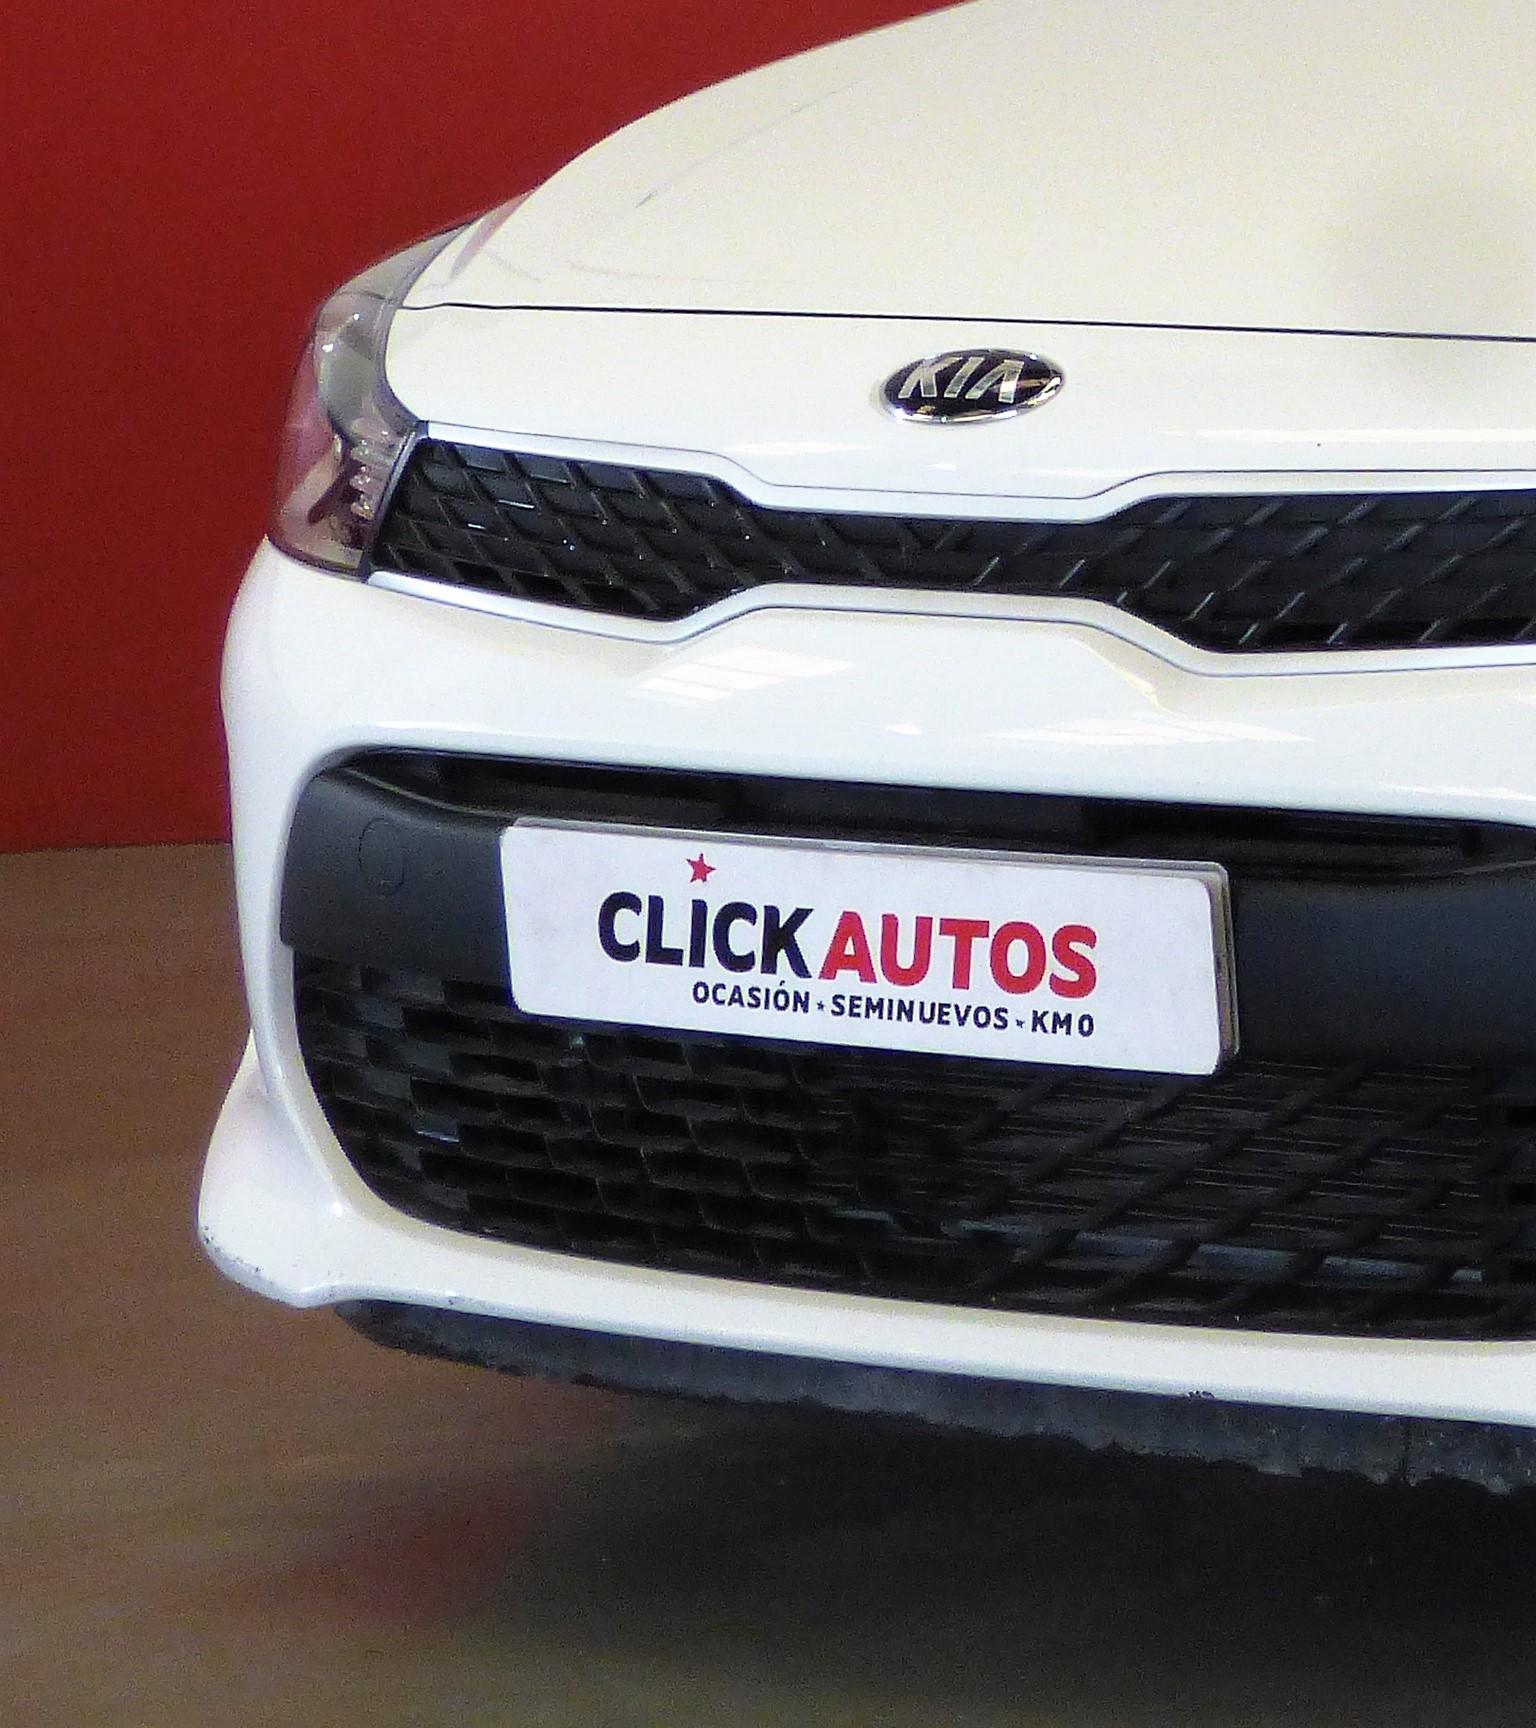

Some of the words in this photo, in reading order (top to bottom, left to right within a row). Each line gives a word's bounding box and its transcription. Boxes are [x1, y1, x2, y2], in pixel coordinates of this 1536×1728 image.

[897, 355, 1025, 404] KIA
[691, 980, 811, 1014] OCASIÓN
[829, 994, 1009, 1030] SEMINUEVOS
